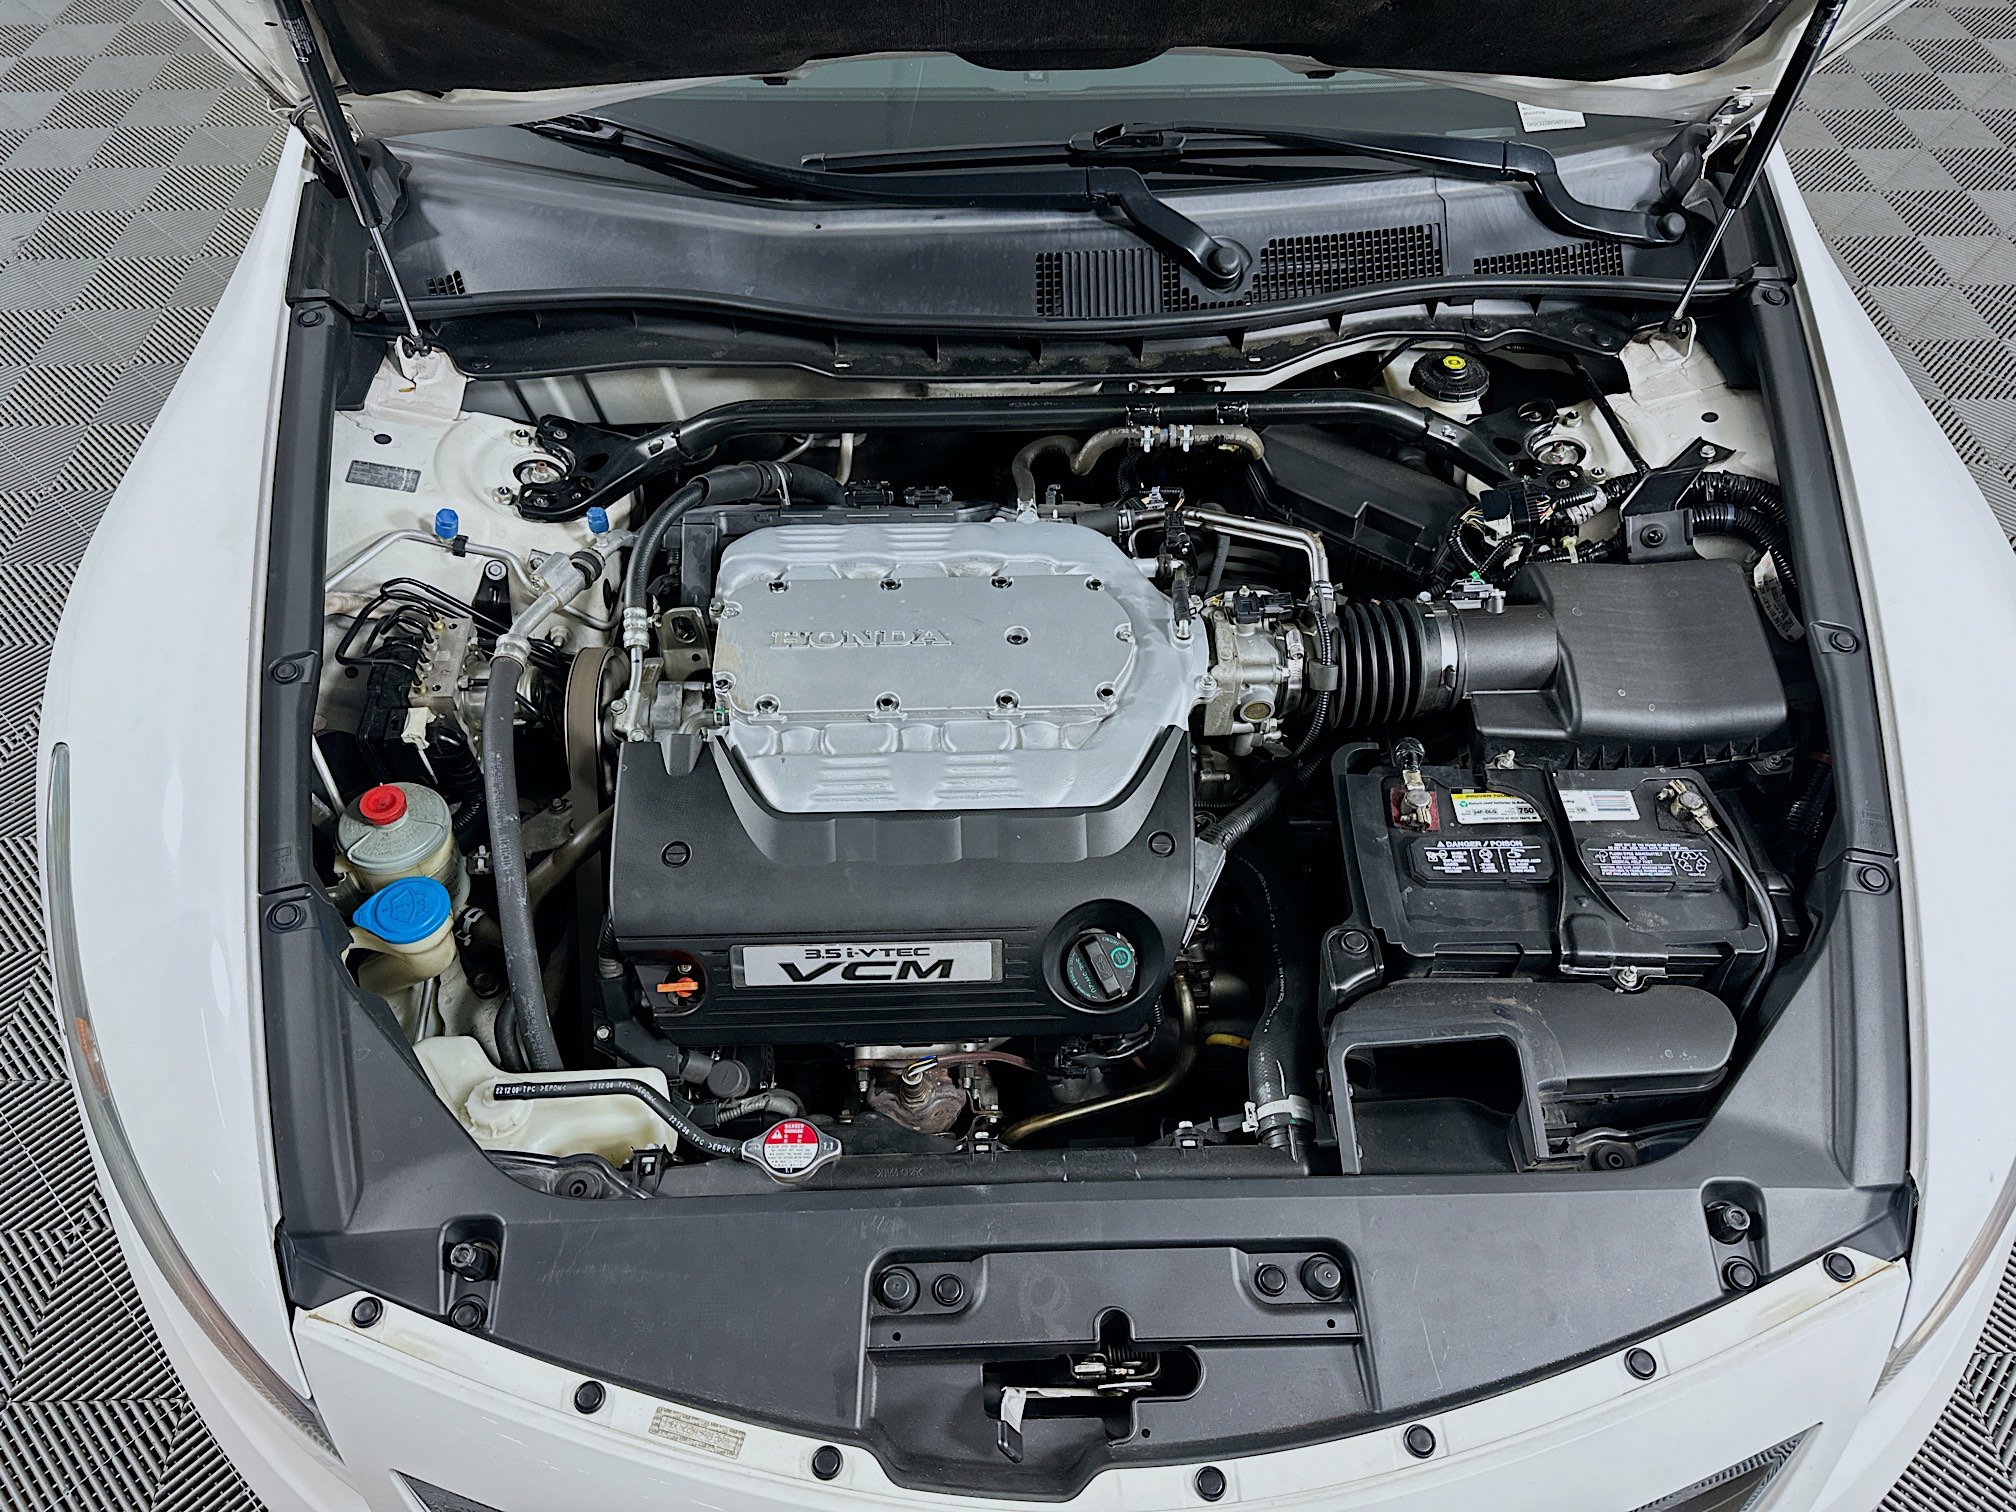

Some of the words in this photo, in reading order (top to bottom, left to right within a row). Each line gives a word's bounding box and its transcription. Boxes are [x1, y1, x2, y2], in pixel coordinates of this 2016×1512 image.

[769, 629, 953, 649] HONDA
[805, 948, 842, 959] 3.5
[846, 947, 930, 957] i-VTEC
[777, 959, 954, 982] VCM
[618, 1081, 631, 1089] TPC
[691, 1133, 705, 1146] TPC
[823, 1142, 834, 1151] 1.1
